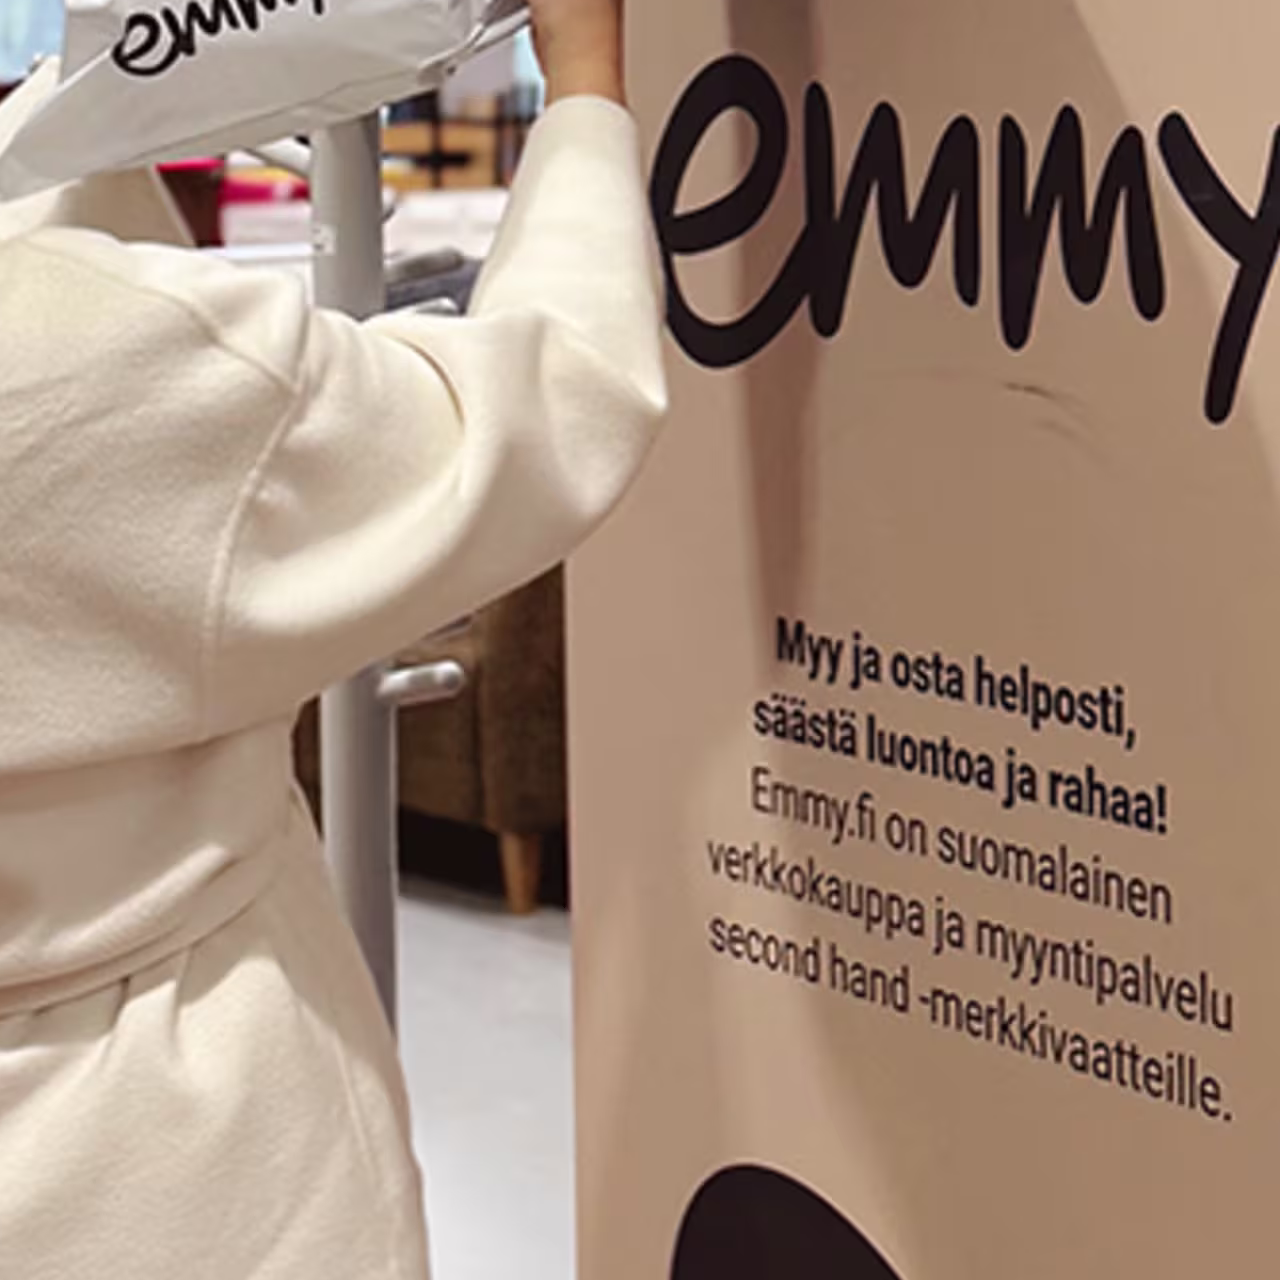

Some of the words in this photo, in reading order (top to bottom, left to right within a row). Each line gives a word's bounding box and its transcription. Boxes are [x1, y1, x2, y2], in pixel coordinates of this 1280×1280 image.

[753, 692, 857, 758] säästä
[866, 714, 996, 792] luontoa
[1001, 747, 1038, 809] ja
[1048, 765, 1169, 834] rahaa!
[775, 616, 843, 685] Myy
[850, 630, 882, 690] ja
[890, 652, 966, 702] osta
[974, 655, 1137, 751] helposti,
[750, 765, 876, 846] Emmy.fi
[885, 809, 928, 857] on
[937, 827, 1174, 926] suomalainen
[706, 838, 926, 941] verkkokauppa
[932, 897, 966, 956] ja
[976, 916, 1235, 1033] myyntipalvelu
[708, 913, 820, 984] second
[829, 943, 911, 1014] hand
[918, 982, 1234, 1122] -merkkivaatteille.
